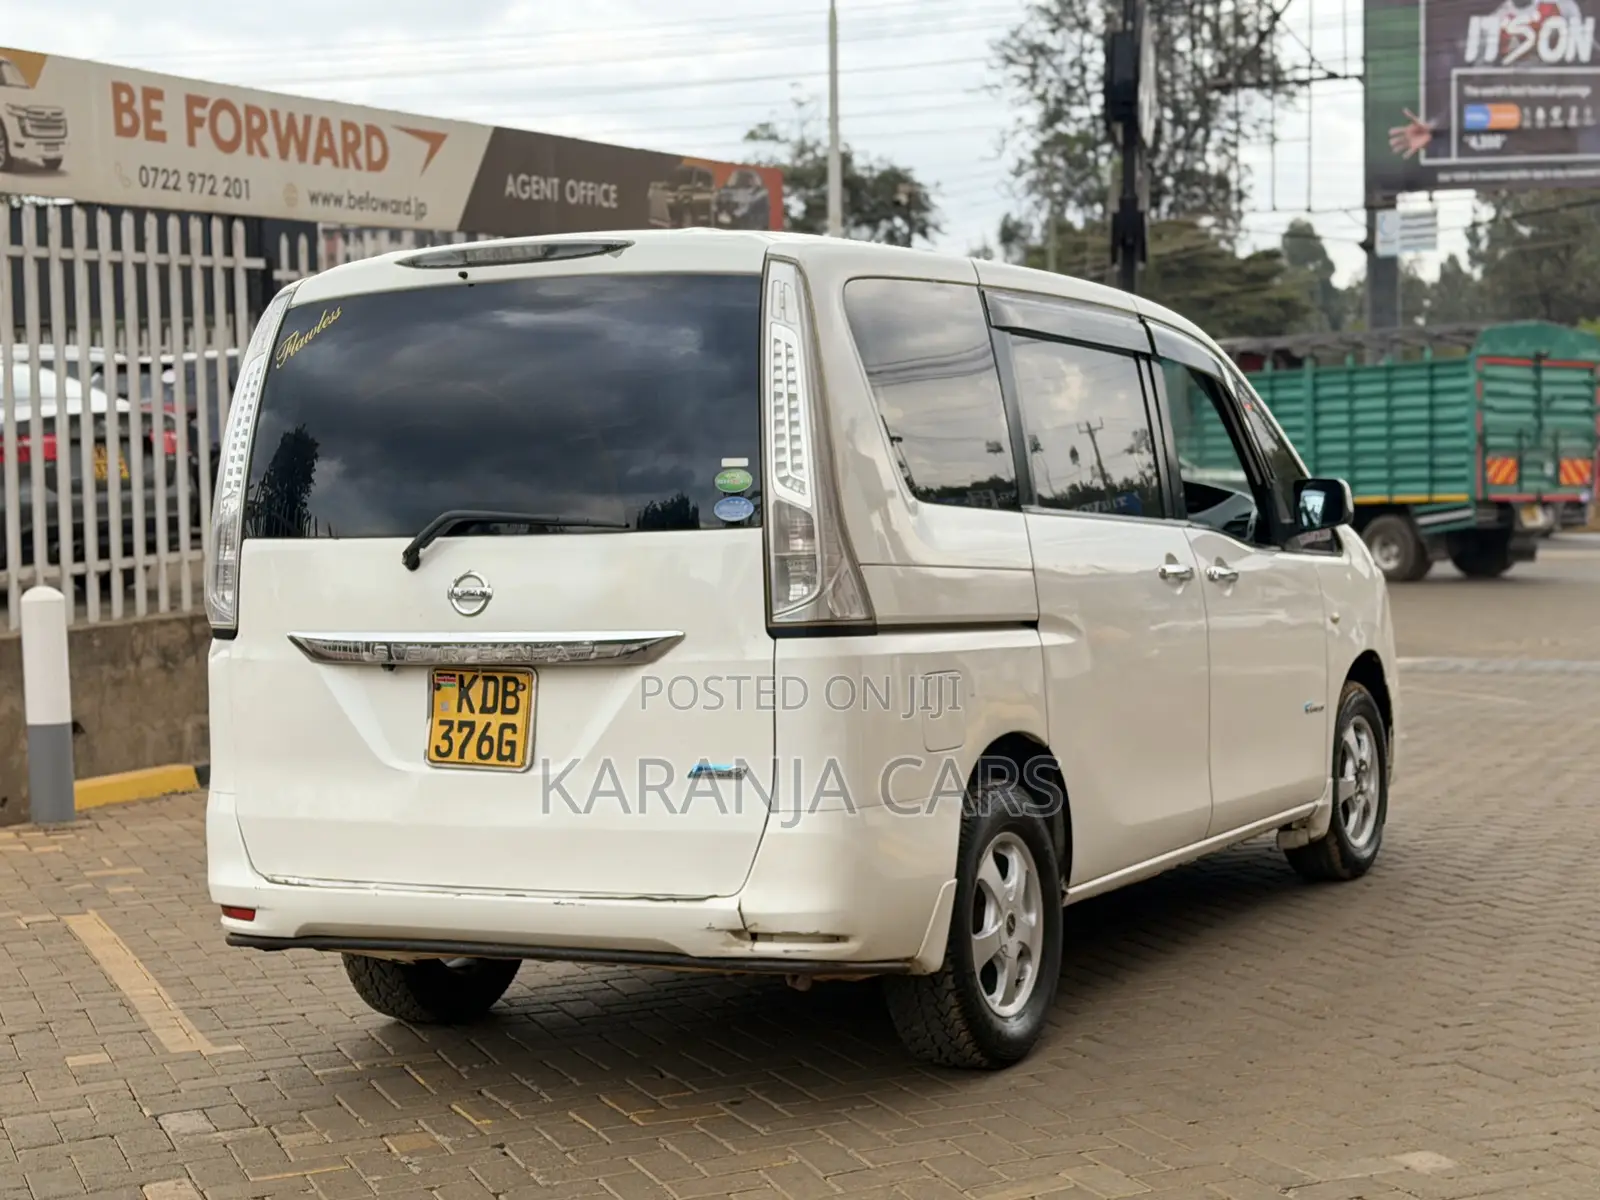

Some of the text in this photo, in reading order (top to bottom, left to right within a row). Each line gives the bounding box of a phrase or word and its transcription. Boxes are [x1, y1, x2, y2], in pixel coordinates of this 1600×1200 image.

[111, 82, 390, 173] BE FORWARD
[138, 165, 250, 201] 0722 972 201
[504, 172, 618, 209] AGENT OFFICE
[275, 306, 342, 369] Flawless
[457, 674, 520, 715] KDB
[434, 719, 517, 762] 376G
